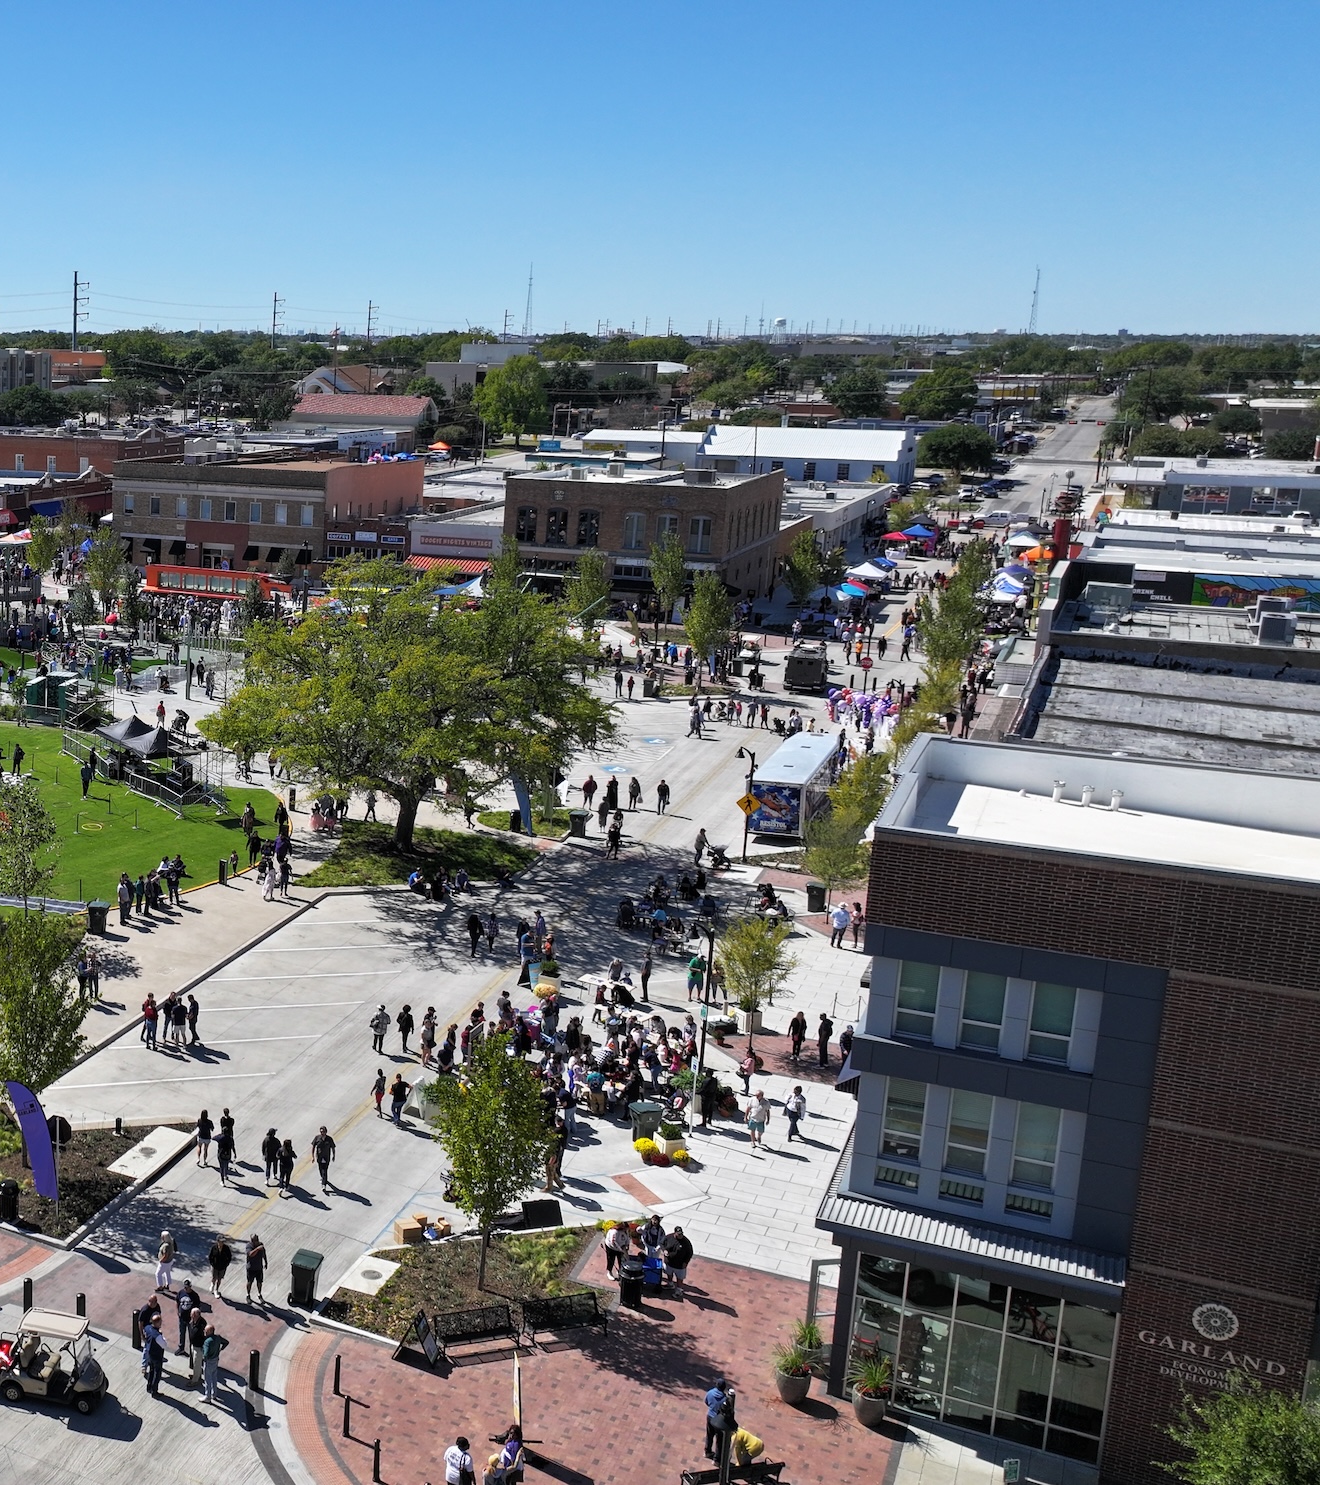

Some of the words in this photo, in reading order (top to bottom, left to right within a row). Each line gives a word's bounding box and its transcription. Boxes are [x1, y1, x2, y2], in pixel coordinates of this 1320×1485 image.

[421, 536, 442, 544] BOOGIE
[442, 538, 465, 546] NIGHTS
[465, 540, 492, 548] VINTAGE
[1138, 1330, 1286, 1376] GARLAND
[1172, 1360, 1236, 1384] ECONOM
